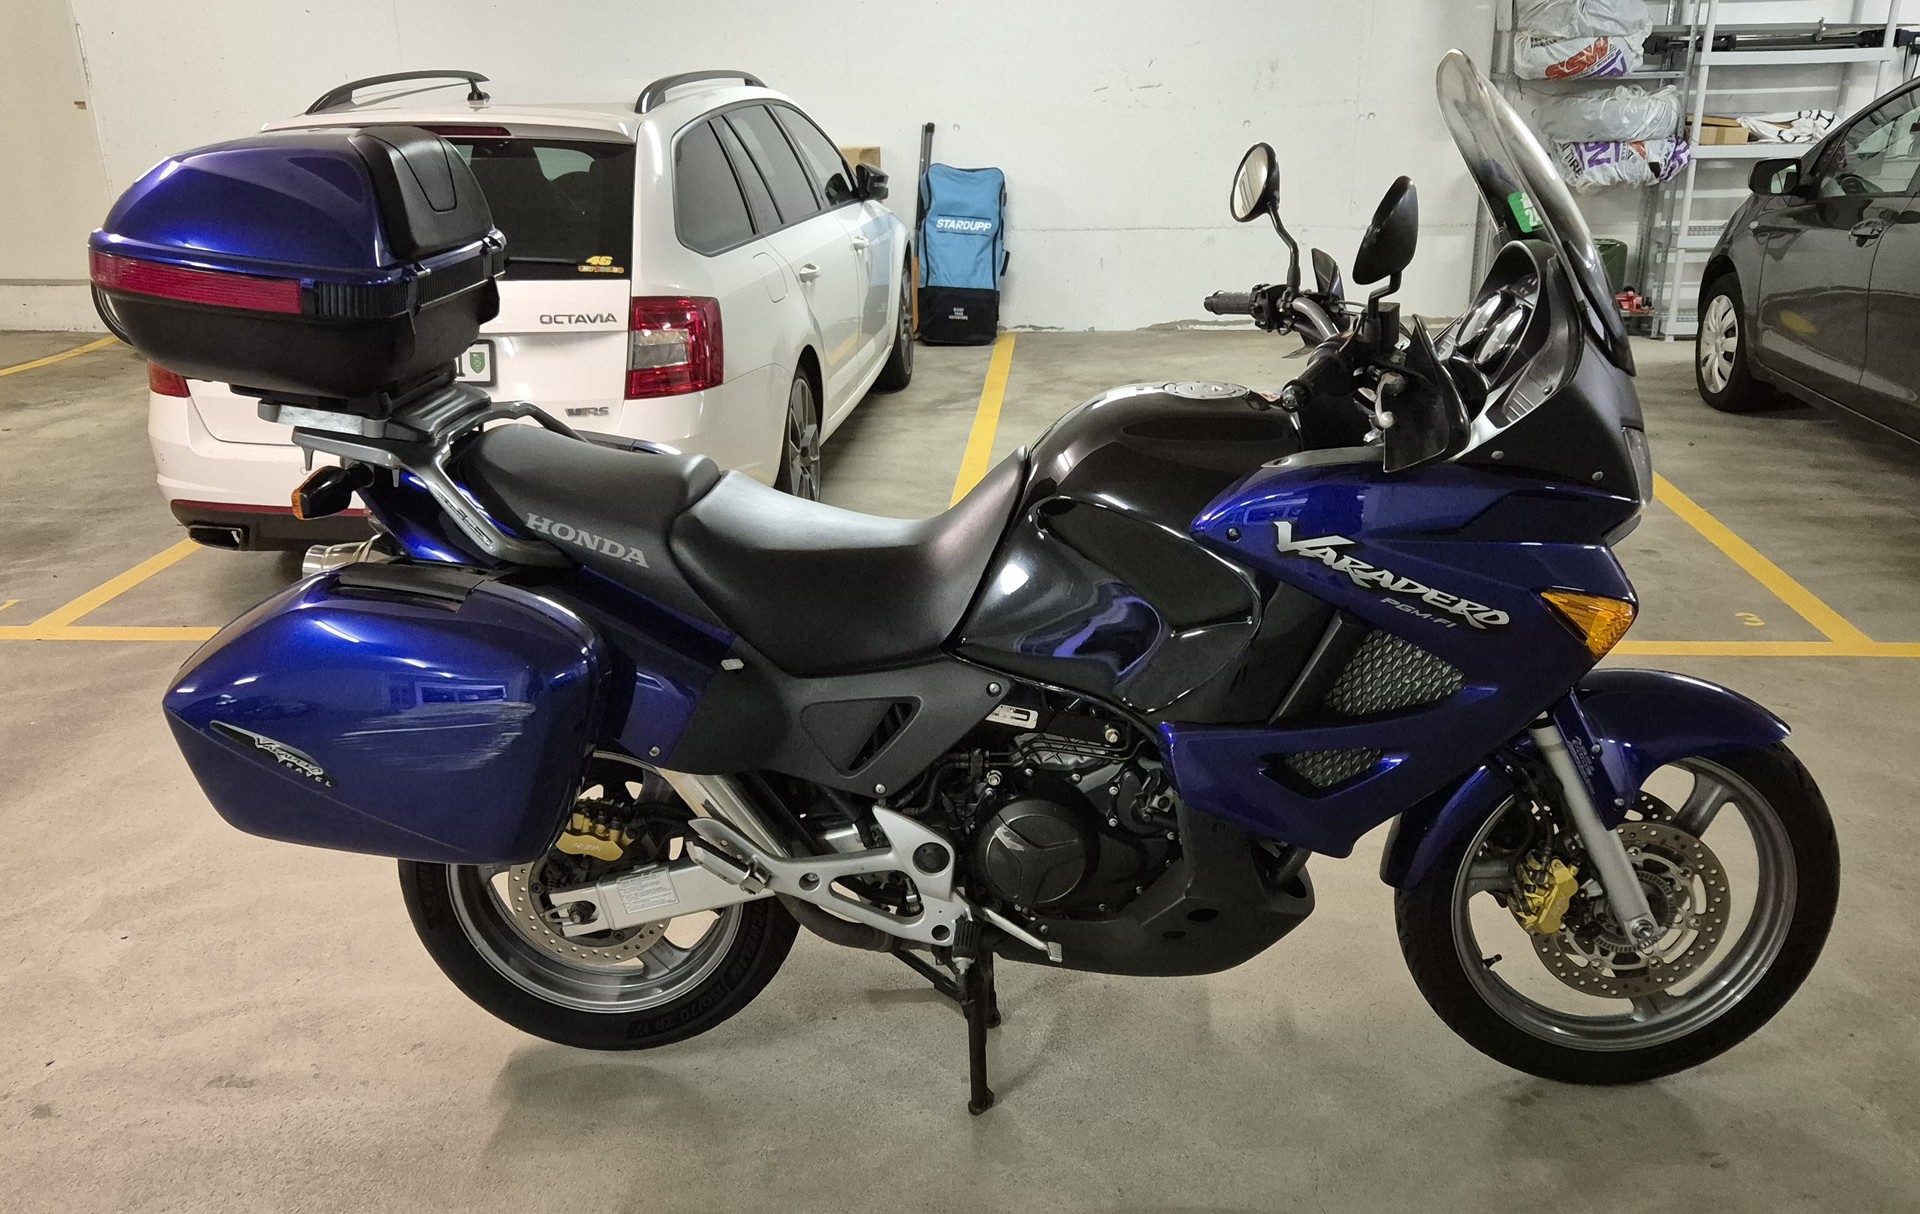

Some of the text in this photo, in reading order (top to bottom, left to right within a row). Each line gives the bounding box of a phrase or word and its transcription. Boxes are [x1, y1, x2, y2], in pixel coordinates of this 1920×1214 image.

[1545, 36, 1609, 80] SSW
[936, 219, 992, 232] STARDUPP
[586, 255, 613, 266] 46
[539, 312, 617, 325] OCTAVIA
[526, 513, 650, 569] HONDA
[1273, 521, 1511, 630] VARADERO
